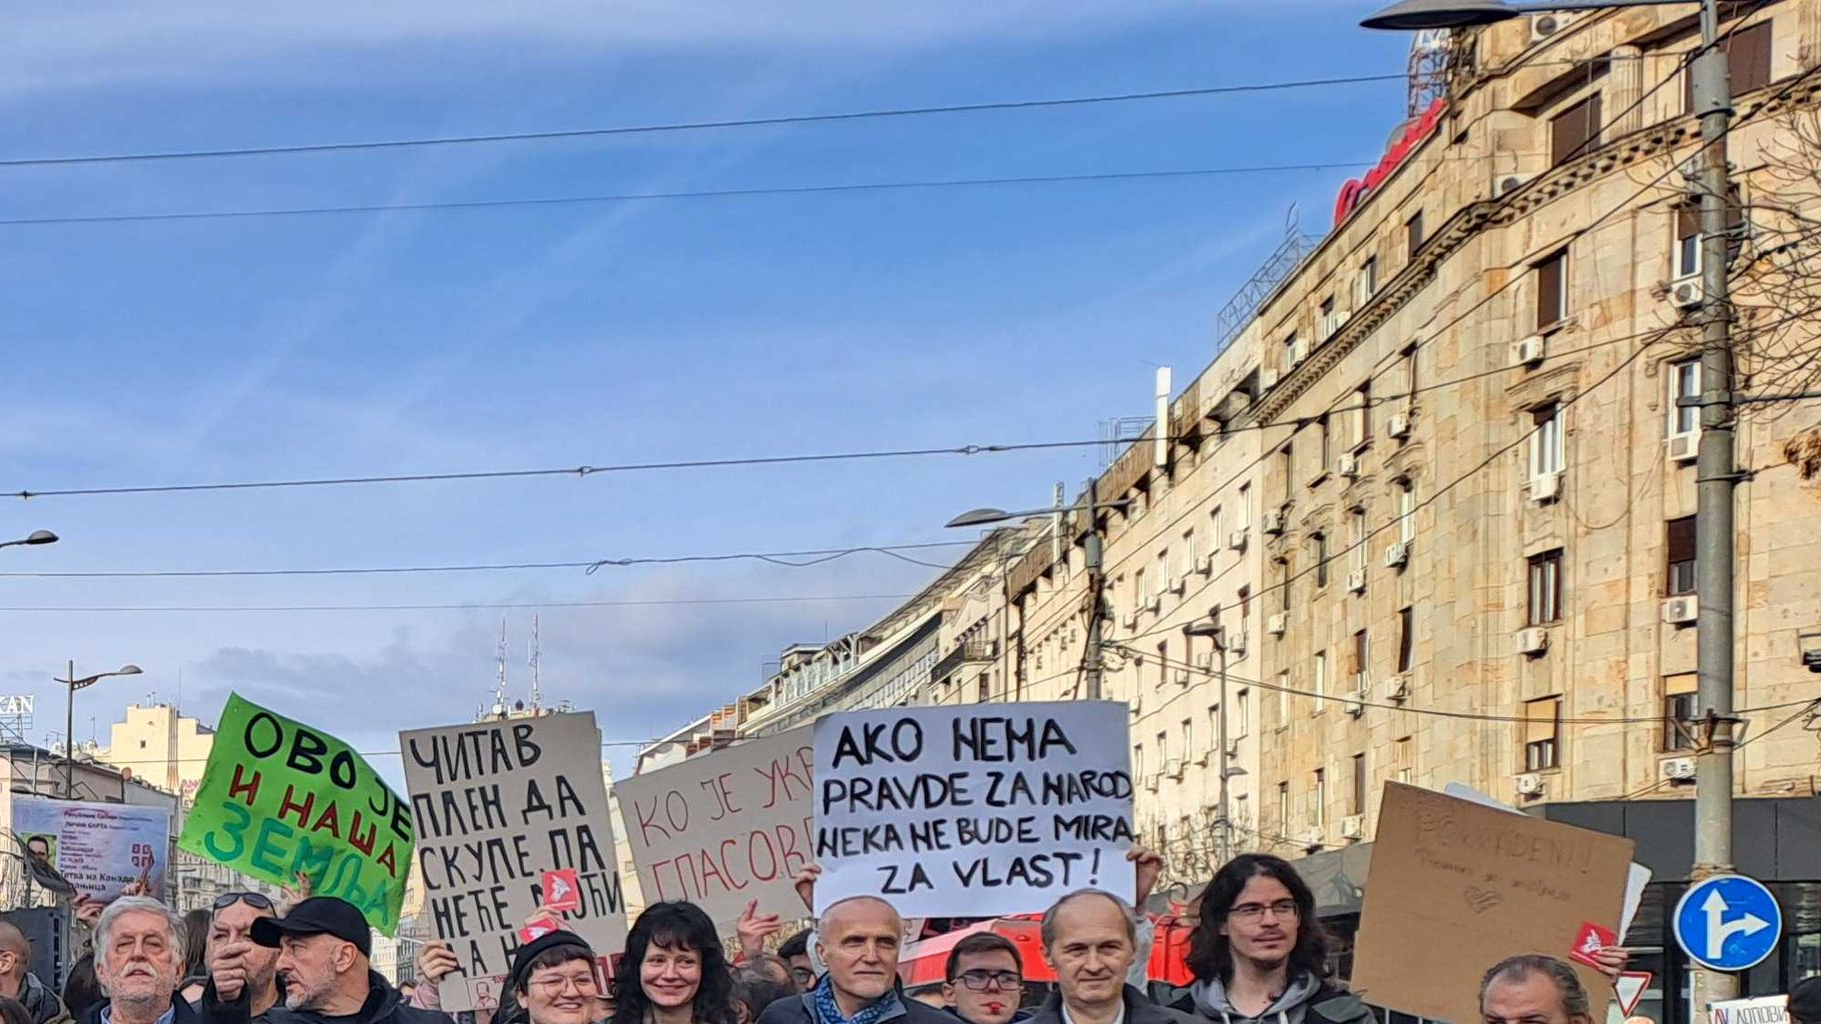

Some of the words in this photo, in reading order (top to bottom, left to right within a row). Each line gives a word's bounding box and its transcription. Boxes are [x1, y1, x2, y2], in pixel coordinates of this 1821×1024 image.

[409, 723, 543, 785] ЧИТАВ
[831, 716, 923, 769] AKO
[952, 716, 1078, 763] NEMA
[243, 711, 357, 790] ОВО
[367, 776, 413, 844] ЈЕ
[634, 789, 689, 848] КО
[699, 771, 743, 822] ЈЕ
[753, 745, 814, 808] УКР
[823, 771, 975, 816] PRAVDE
[984, 770, 1037, 807] ZA
[228, 763, 264, 807] И
[279, 783, 398, 878] НАША
[412, 782, 509, 840] ПЛЕН
[521, 774, 587, 825] ДА
[548, 824, 606, 880] ПА
[816, 823, 904, 859] NEKA
[911, 818, 951, 852] NE
[956, 816, 1041, 846] BUDE
[1053, 814, 1136, 844] MIRA
[877, 863, 934, 894] ZA
[951, 848, 1102, 890] VLAST!
[431, 885, 513, 940] НЕЋЕ
